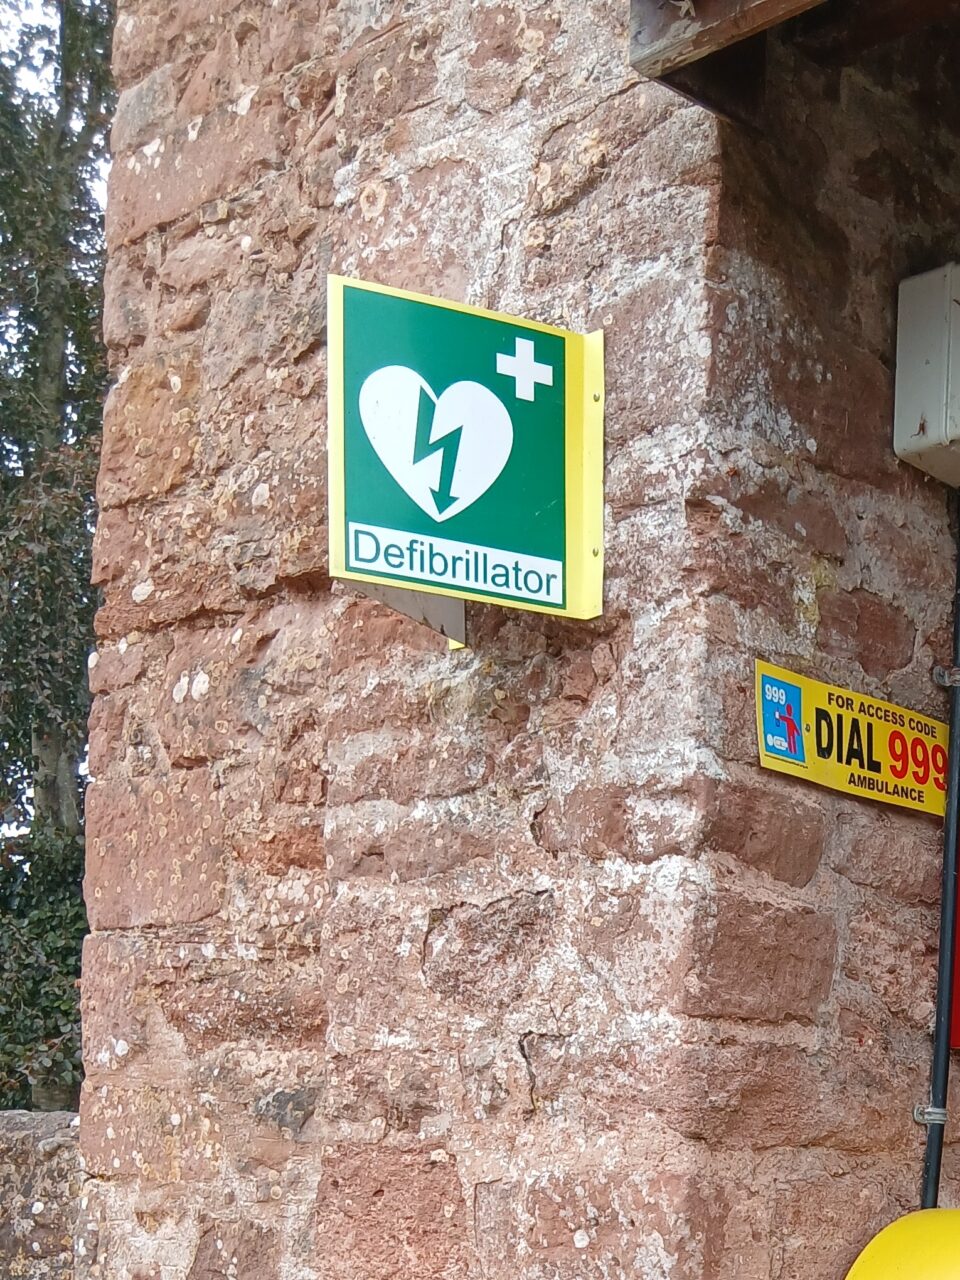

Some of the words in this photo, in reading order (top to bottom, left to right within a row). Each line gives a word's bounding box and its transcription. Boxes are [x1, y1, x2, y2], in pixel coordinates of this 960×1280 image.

[354, 529, 557, 596] Defibrillator
[765, 684, 786, 704] 999
[827, 691, 854, 711] FOR
[858, 701, 905, 727] ACCESS
[908, 717, 937, 739] CODE
[815, 707, 881, 774] DIAL
[888, 729, 949, 793] 999
[847, 772, 925, 804] AMBULANCE
